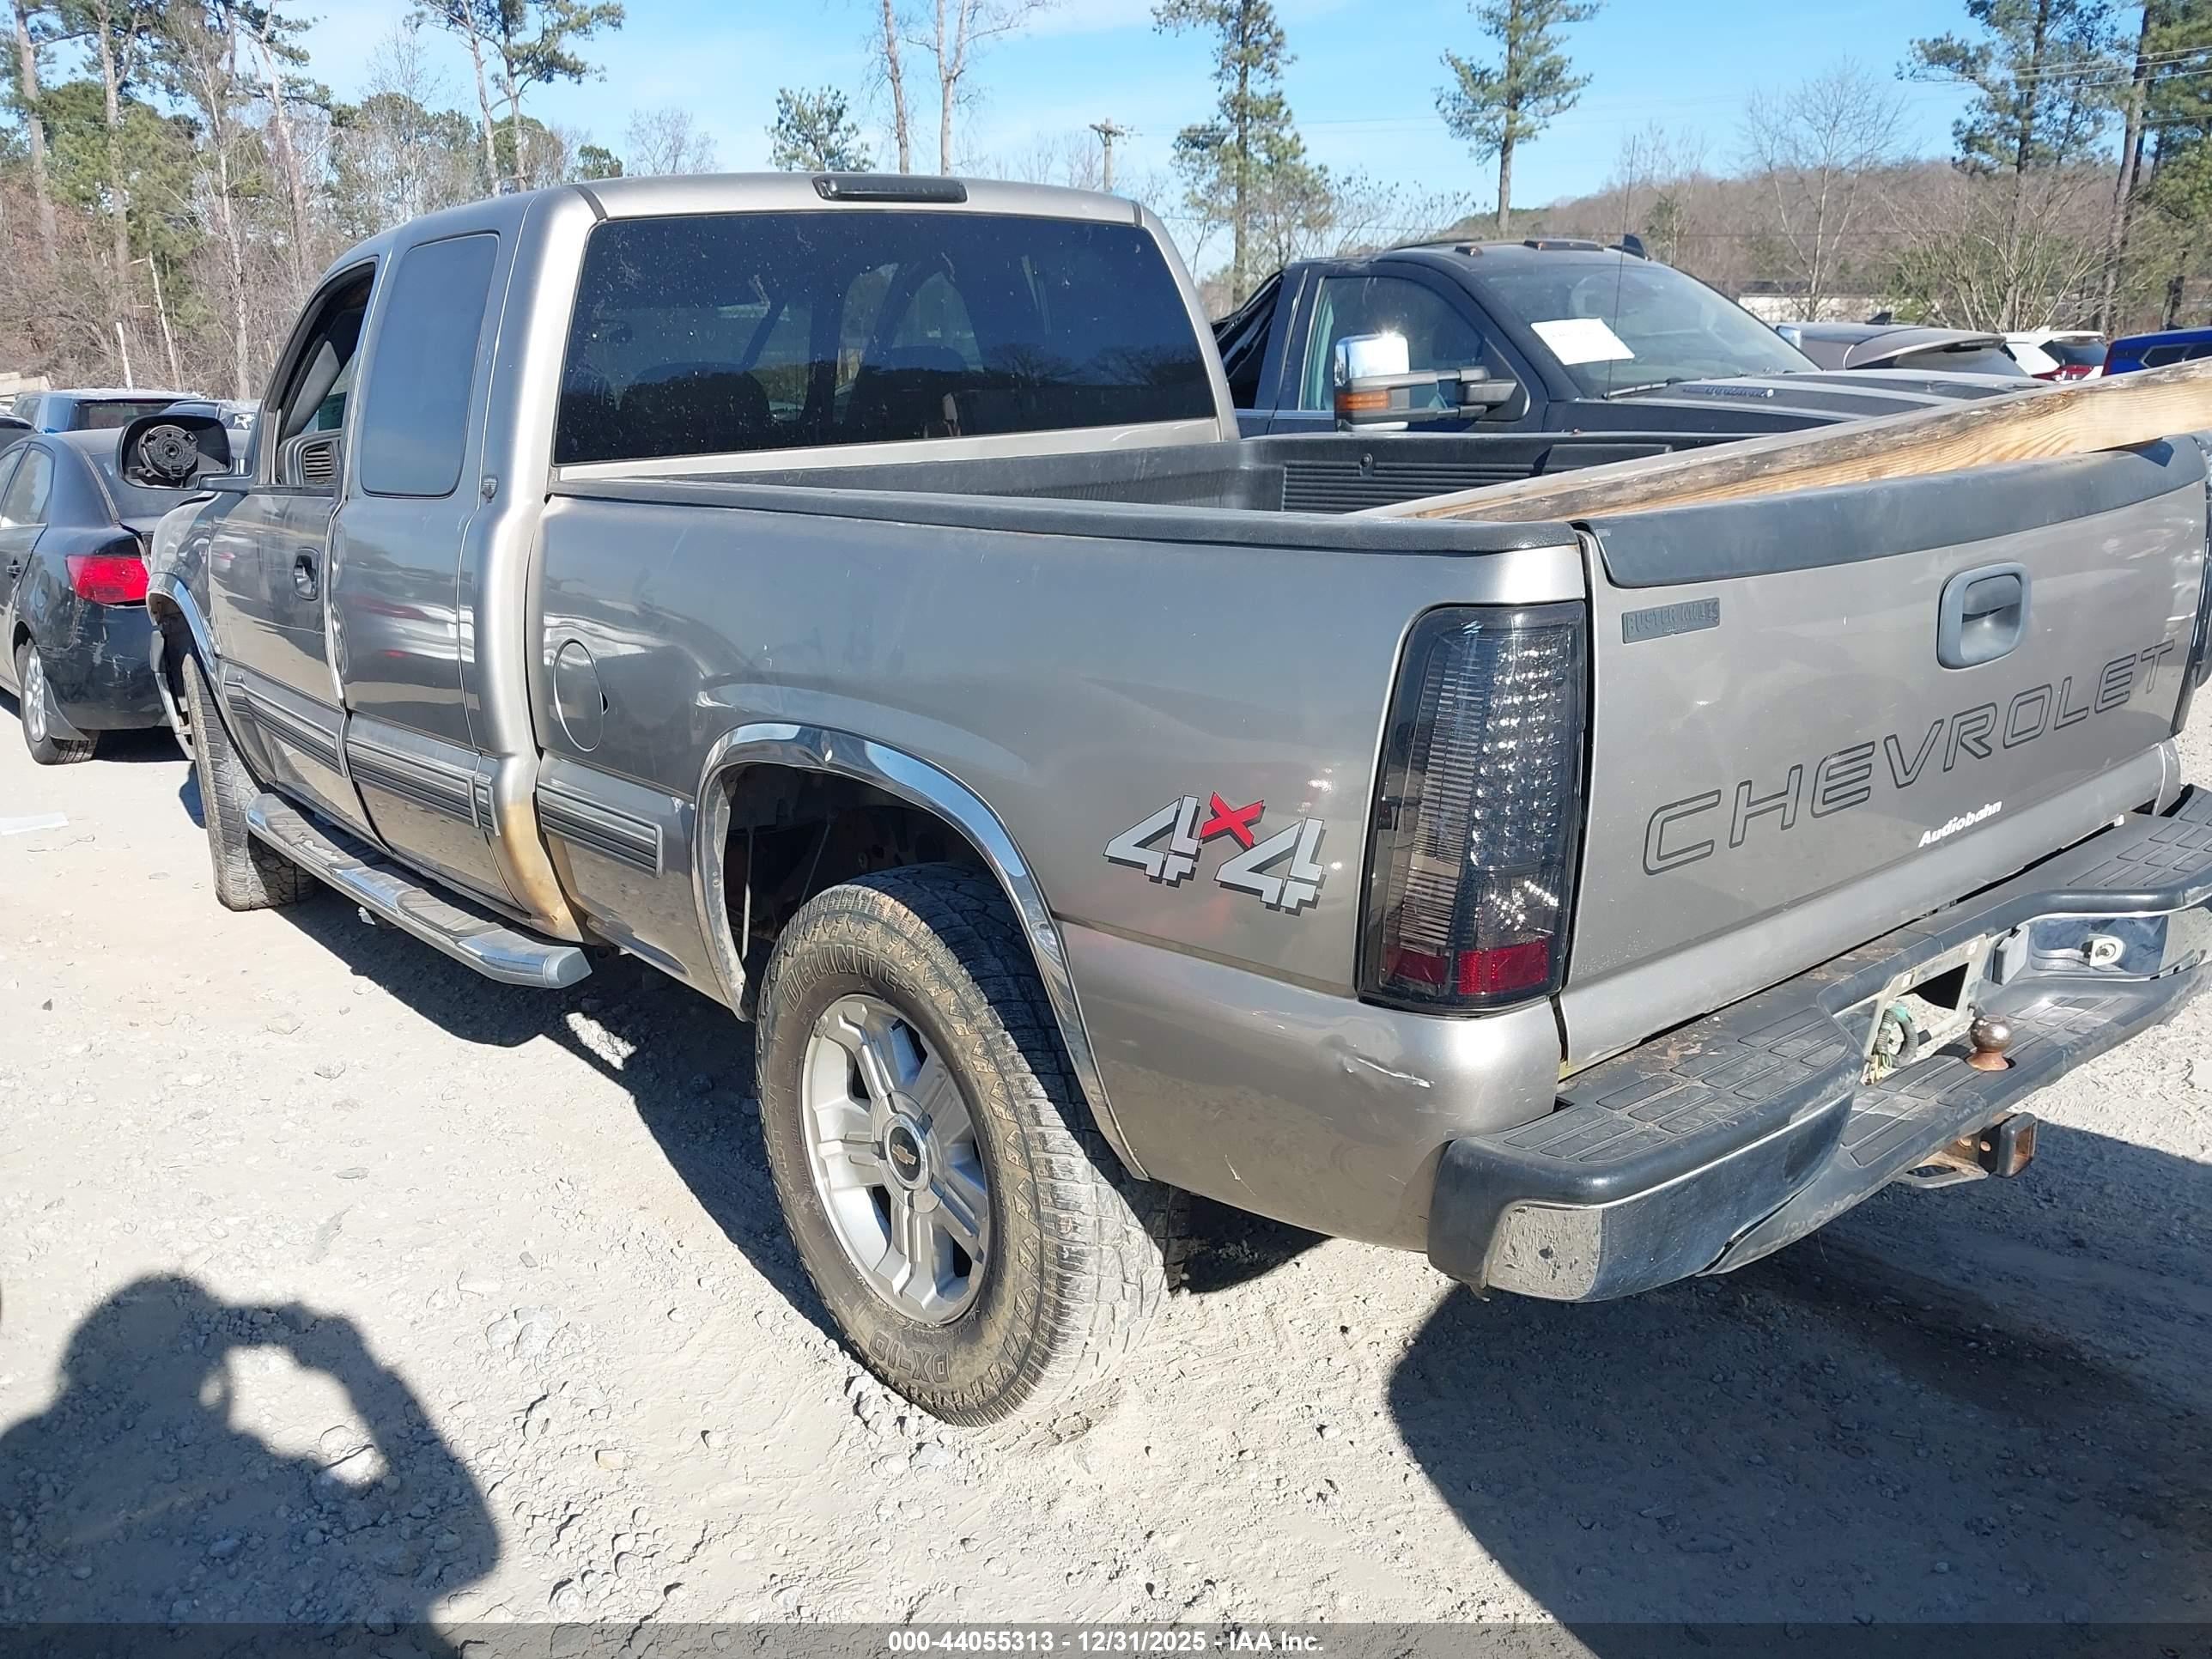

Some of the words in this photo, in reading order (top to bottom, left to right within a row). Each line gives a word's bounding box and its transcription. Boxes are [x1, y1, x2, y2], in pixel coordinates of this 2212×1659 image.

[1643, 639, 2176, 876] CHEVROLET
[1917, 800, 2002, 848] Audiobahn
[868, 1330, 951, 1384] DX-10
